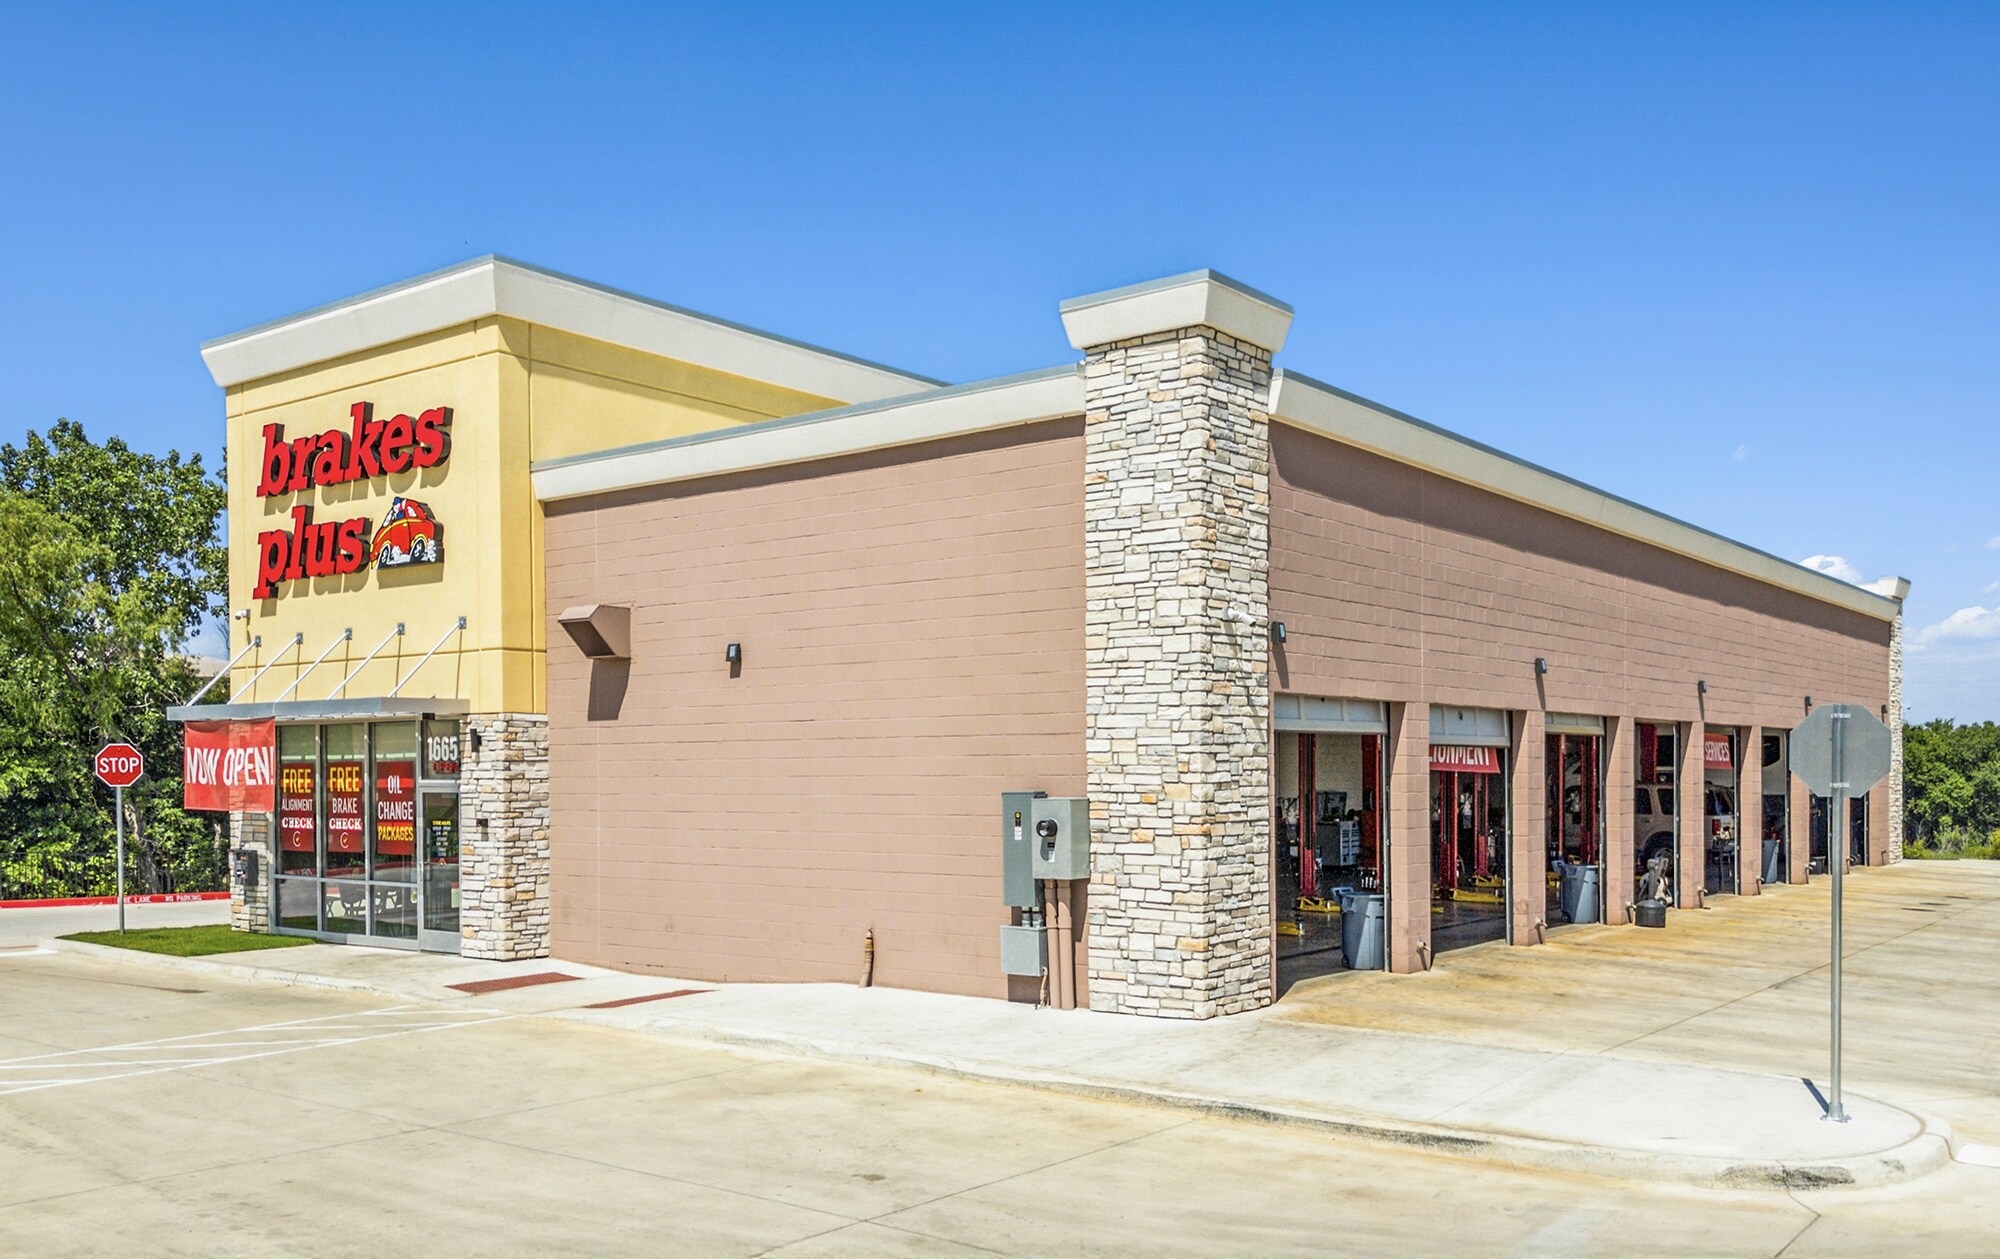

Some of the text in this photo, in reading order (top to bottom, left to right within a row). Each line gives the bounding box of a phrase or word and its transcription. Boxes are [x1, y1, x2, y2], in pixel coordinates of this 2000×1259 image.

[257, 401, 450, 497] brakes
[253, 505, 370, 600] plus
[427, 736, 458, 761] 1665
[1704, 741, 1730, 762] SERVICES
[99, 757, 140, 774] STOP
[187, 746, 274, 787] NOW OPEN!
[283, 768, 312, 793] FREE
[329, 766, 360, 792] FREE
[387, 775, 403, 794] OIL
[281, 798, 313, 811] ALIGNMENT
[332, 797, 358, 814] BRAKE
[377, 801, 414, 820] CHANGE
[281, 817, 314, 829] CHECK
[329, 817, 362, 830] CHECK
[377, 825, 414, 841] PACKAGES
